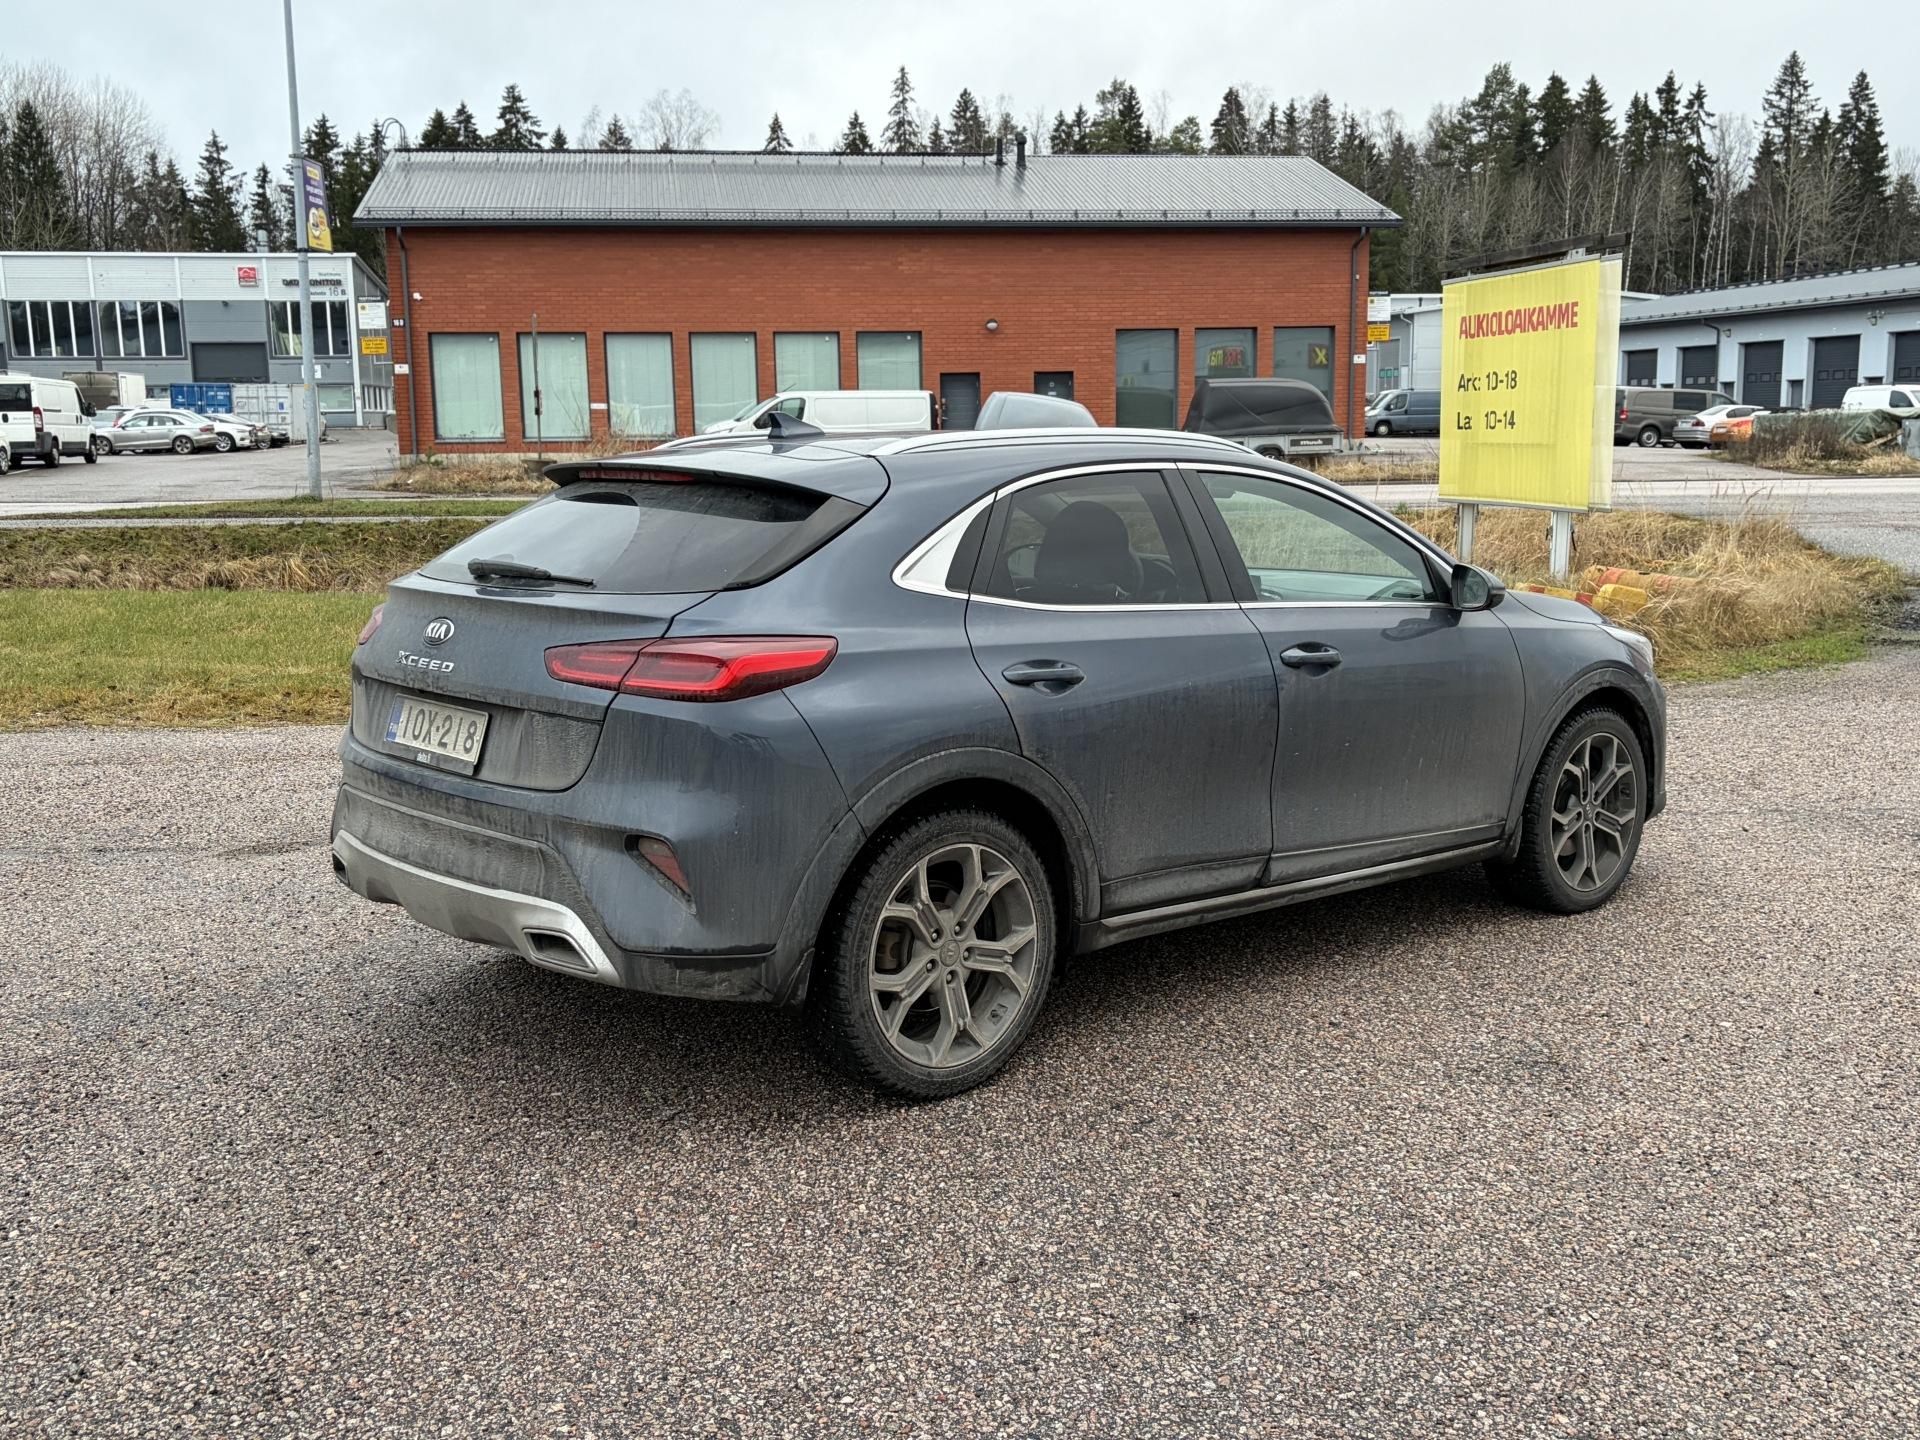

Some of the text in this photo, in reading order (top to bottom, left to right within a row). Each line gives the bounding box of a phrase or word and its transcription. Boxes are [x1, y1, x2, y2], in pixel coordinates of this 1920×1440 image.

[1459, 301, 1579, 340] AUKIOLOAIKAMME
[1457, 370, 1518, 392] Ark: 10-18
[1485, 410, 1516, 430] 10-14
[425, 622, 448, 640] KIA
[396, 650, 455, 673] XCEED
[402, 705, 478, 755] IOX-218
